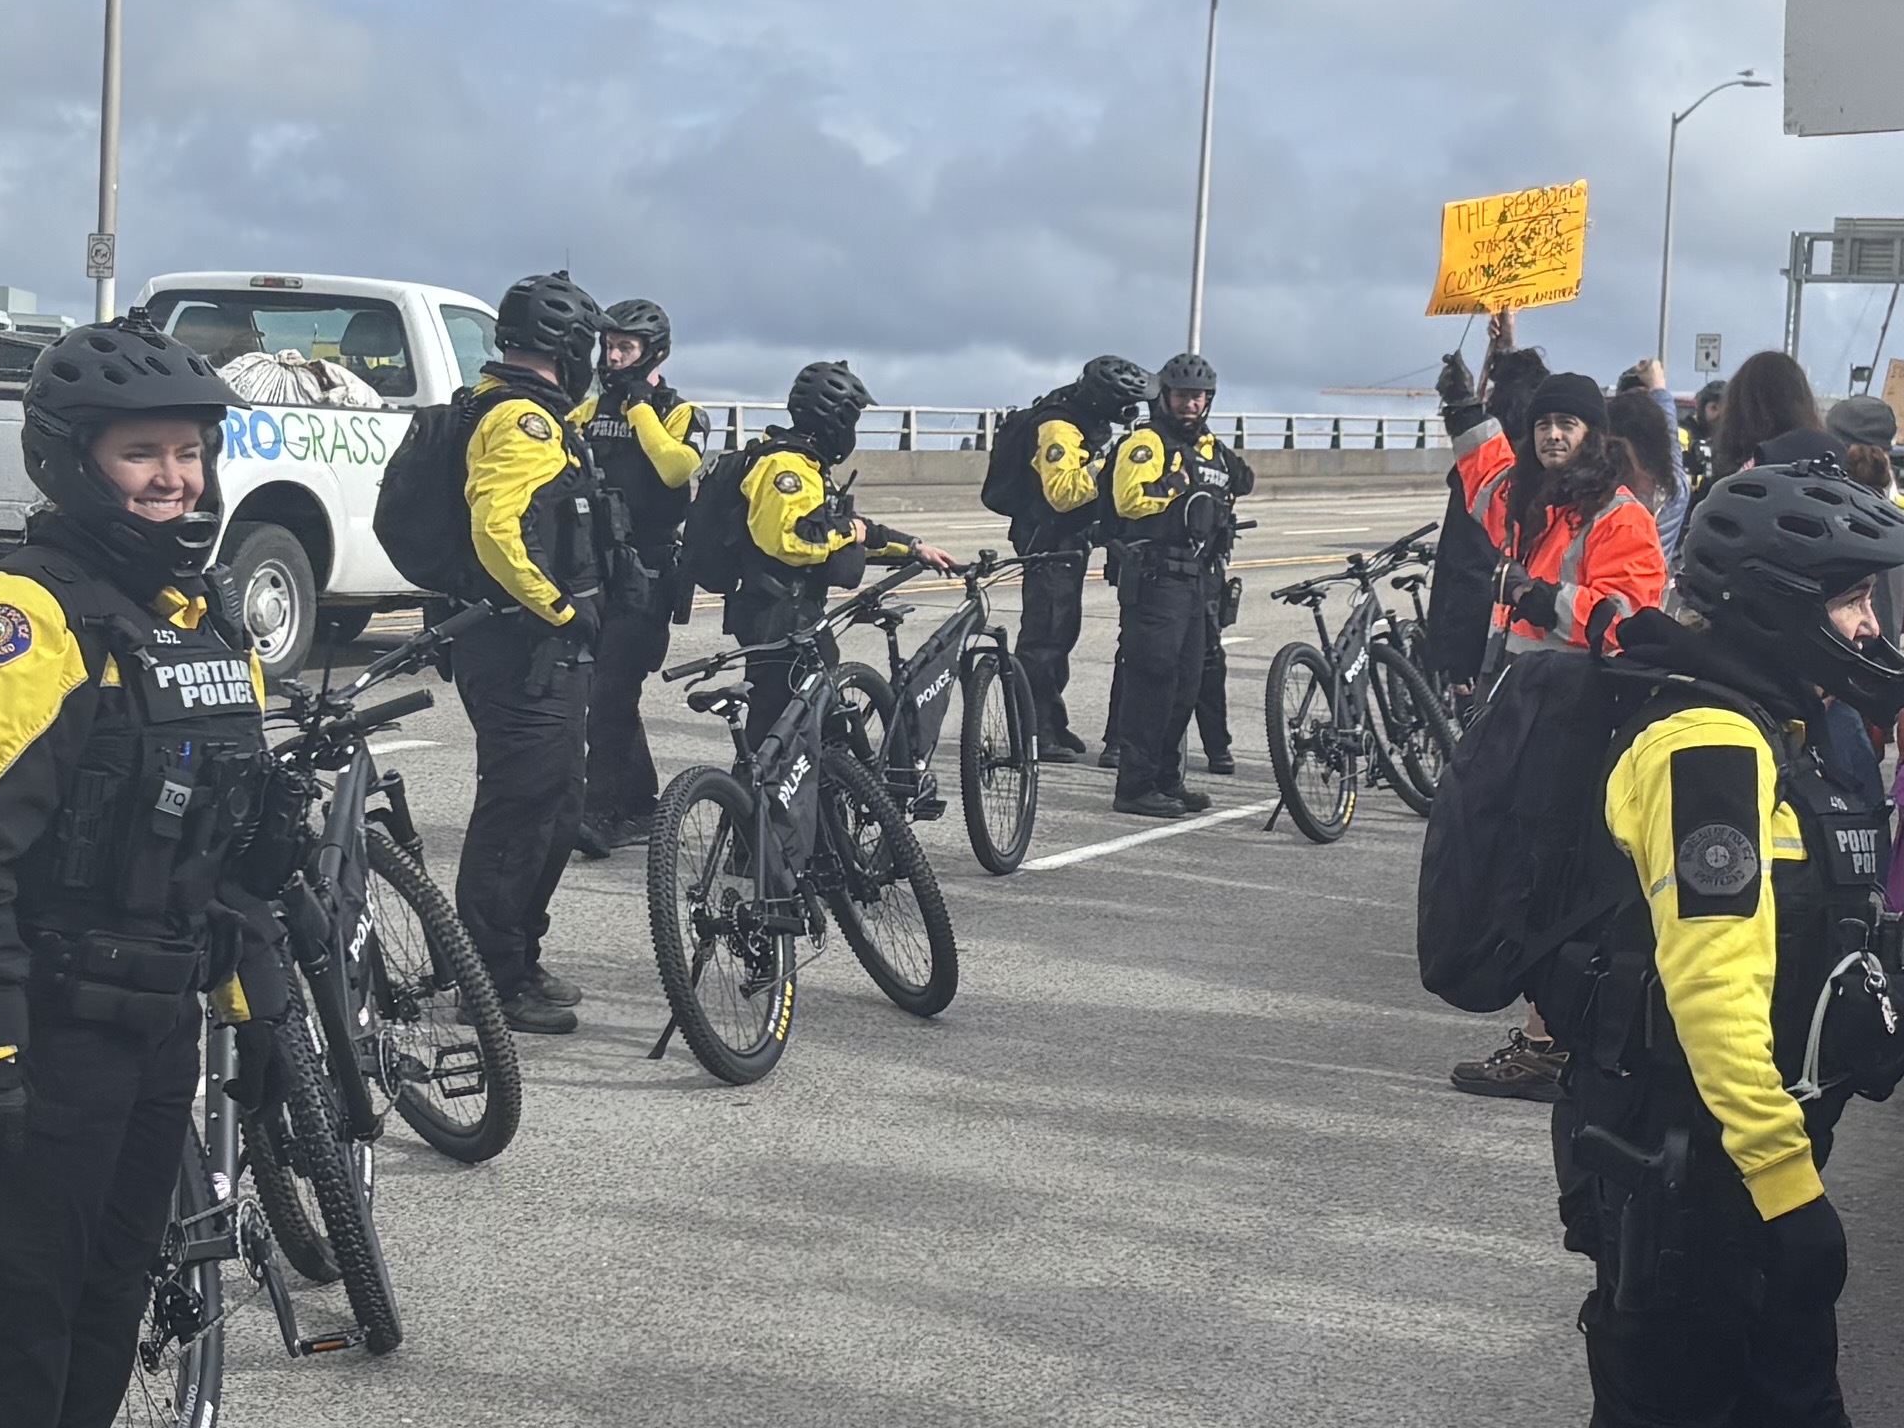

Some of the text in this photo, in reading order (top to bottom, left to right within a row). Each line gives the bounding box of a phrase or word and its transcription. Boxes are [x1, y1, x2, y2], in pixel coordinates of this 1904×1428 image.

[1452, 200, 1499, 233] THE
[226, 410, 386, 465] ROGRASS
[153, 628, 182, 644] 252
[180, 682, 255, 709] POLICE
[915, 668, 951, 709] POLICE
[165, 789, 187, 807] TQ
[777, 752, 812, 812] POLICE
